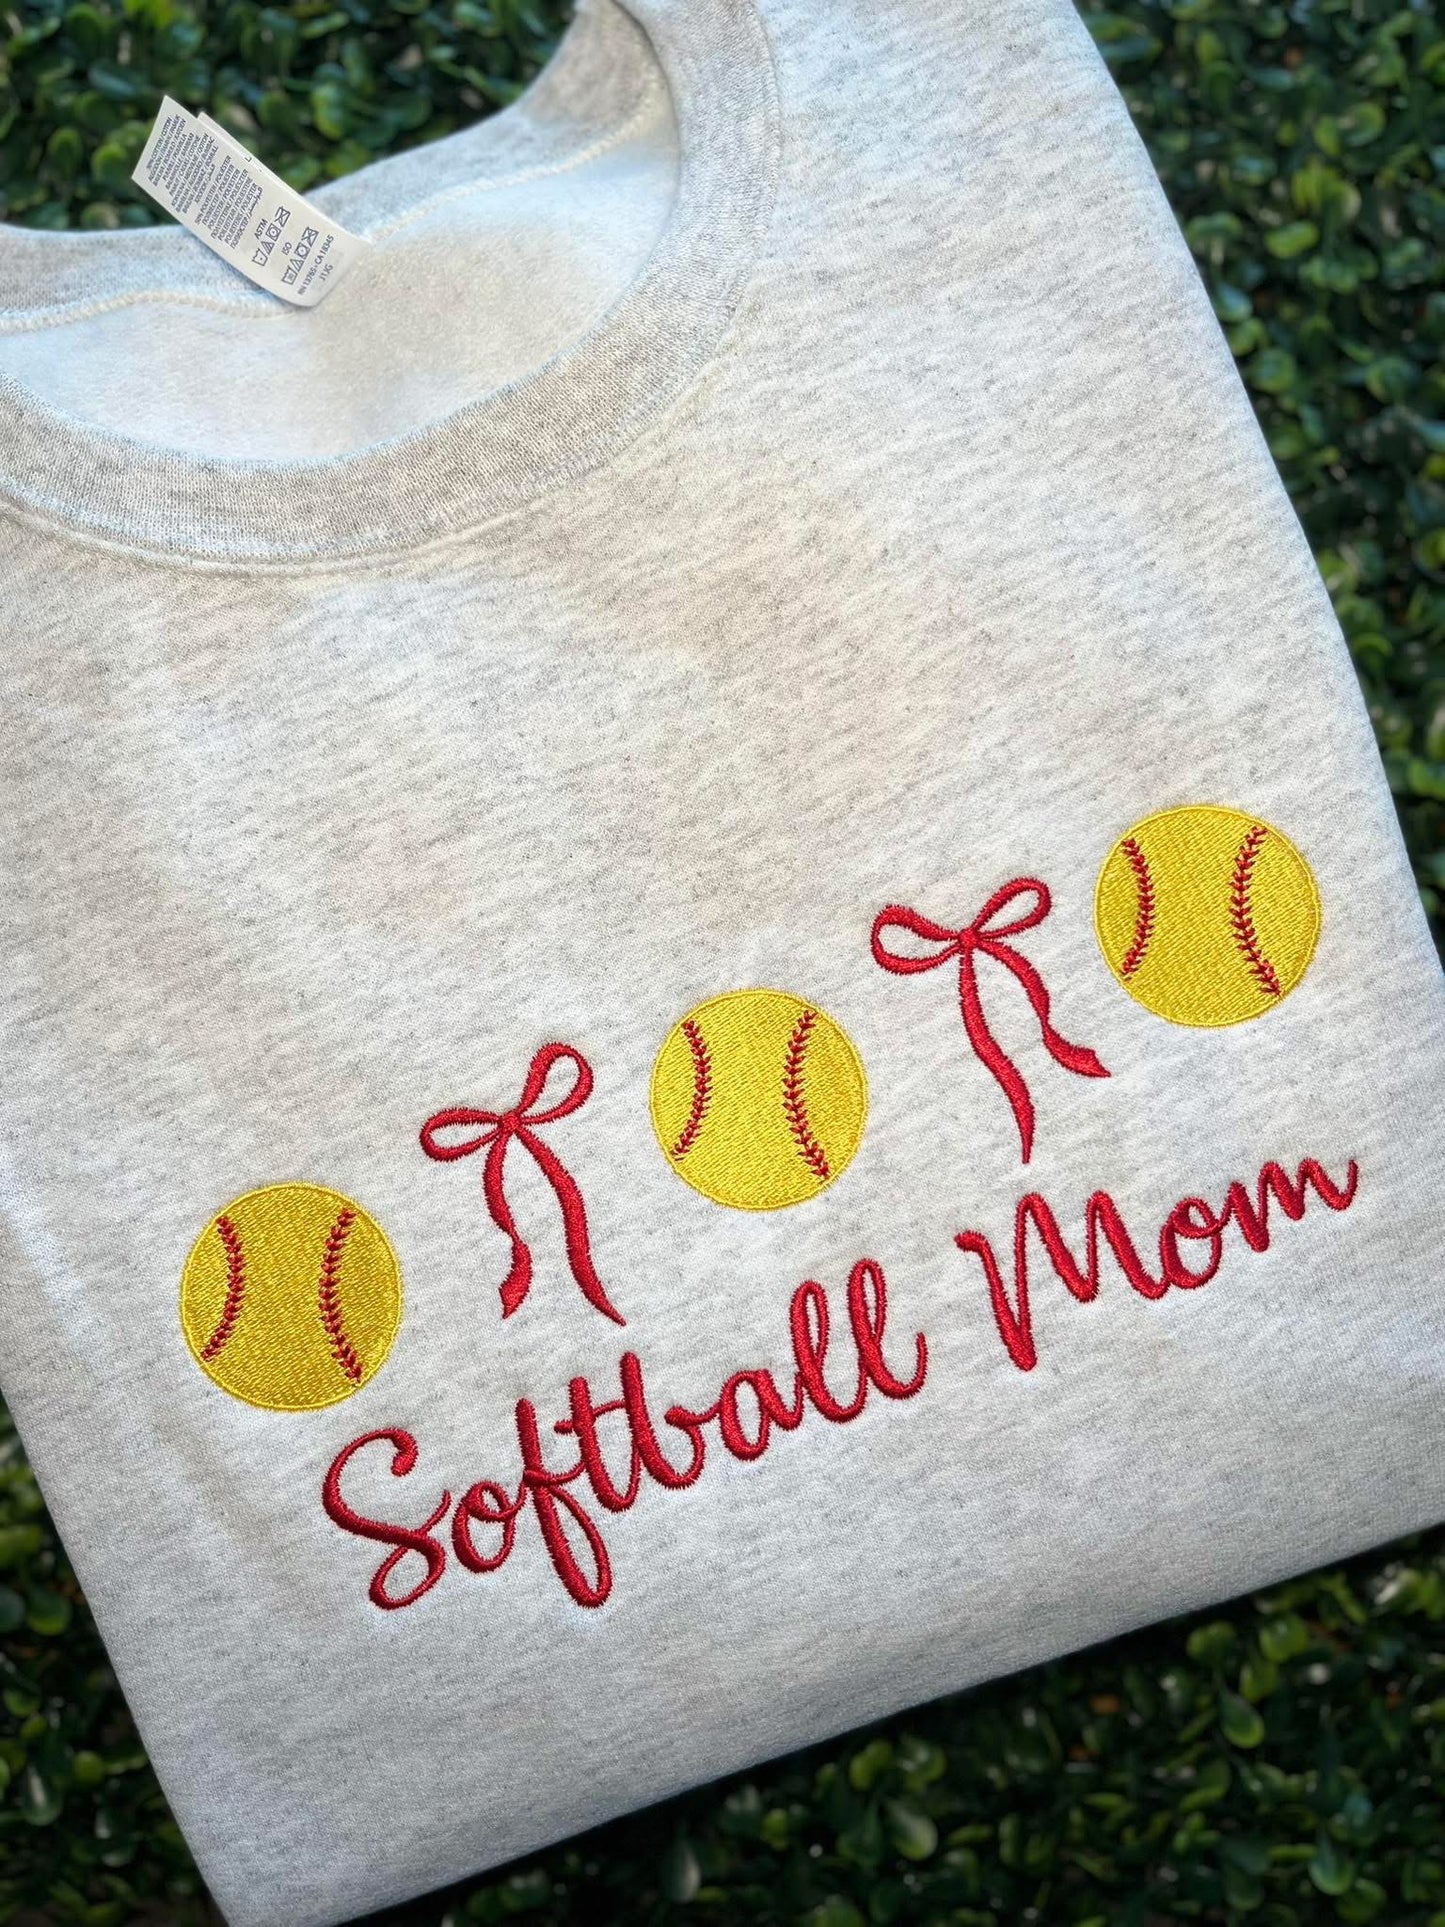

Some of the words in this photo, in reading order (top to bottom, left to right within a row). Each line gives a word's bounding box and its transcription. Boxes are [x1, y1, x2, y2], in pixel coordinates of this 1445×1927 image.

[254, 218, 269, 240] ASTM
[281, 241, 293, 256] ISO
[314, 253, 325, 266] CA
[320, 234, 335, 255] 18345
[322, 1257, 929, 1611] Softball
[954, 1156, 1359, 1371] Mom
